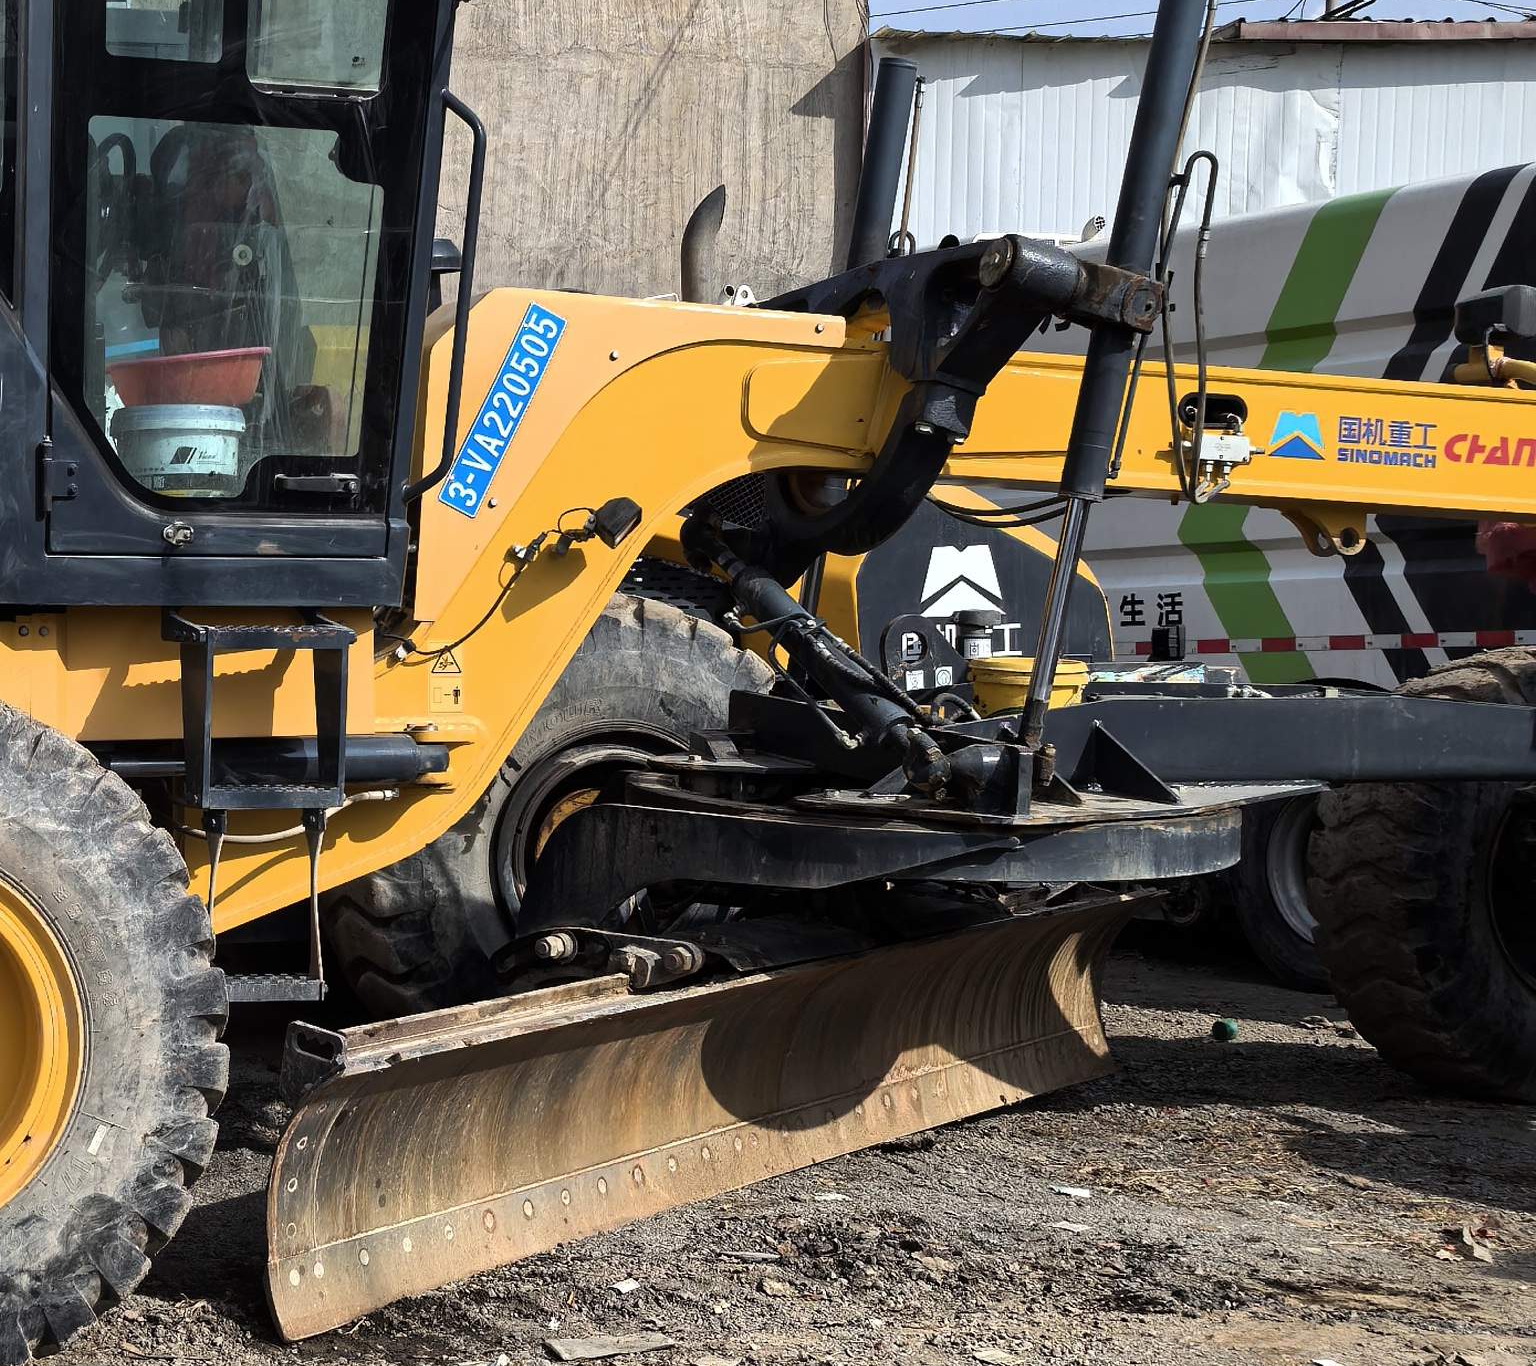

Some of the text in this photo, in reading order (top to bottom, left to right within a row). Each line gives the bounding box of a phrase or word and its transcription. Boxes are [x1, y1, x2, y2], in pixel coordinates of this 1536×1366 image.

[448, 312, 558, 508] 3-VA220505
[1338, 416, 1438, 450] 国机重工
[1337, 447, 1437, 468] SINOMACH
[1120, 592, 1183, 627] 生活
[902, 622, 1023, 661] 国工
